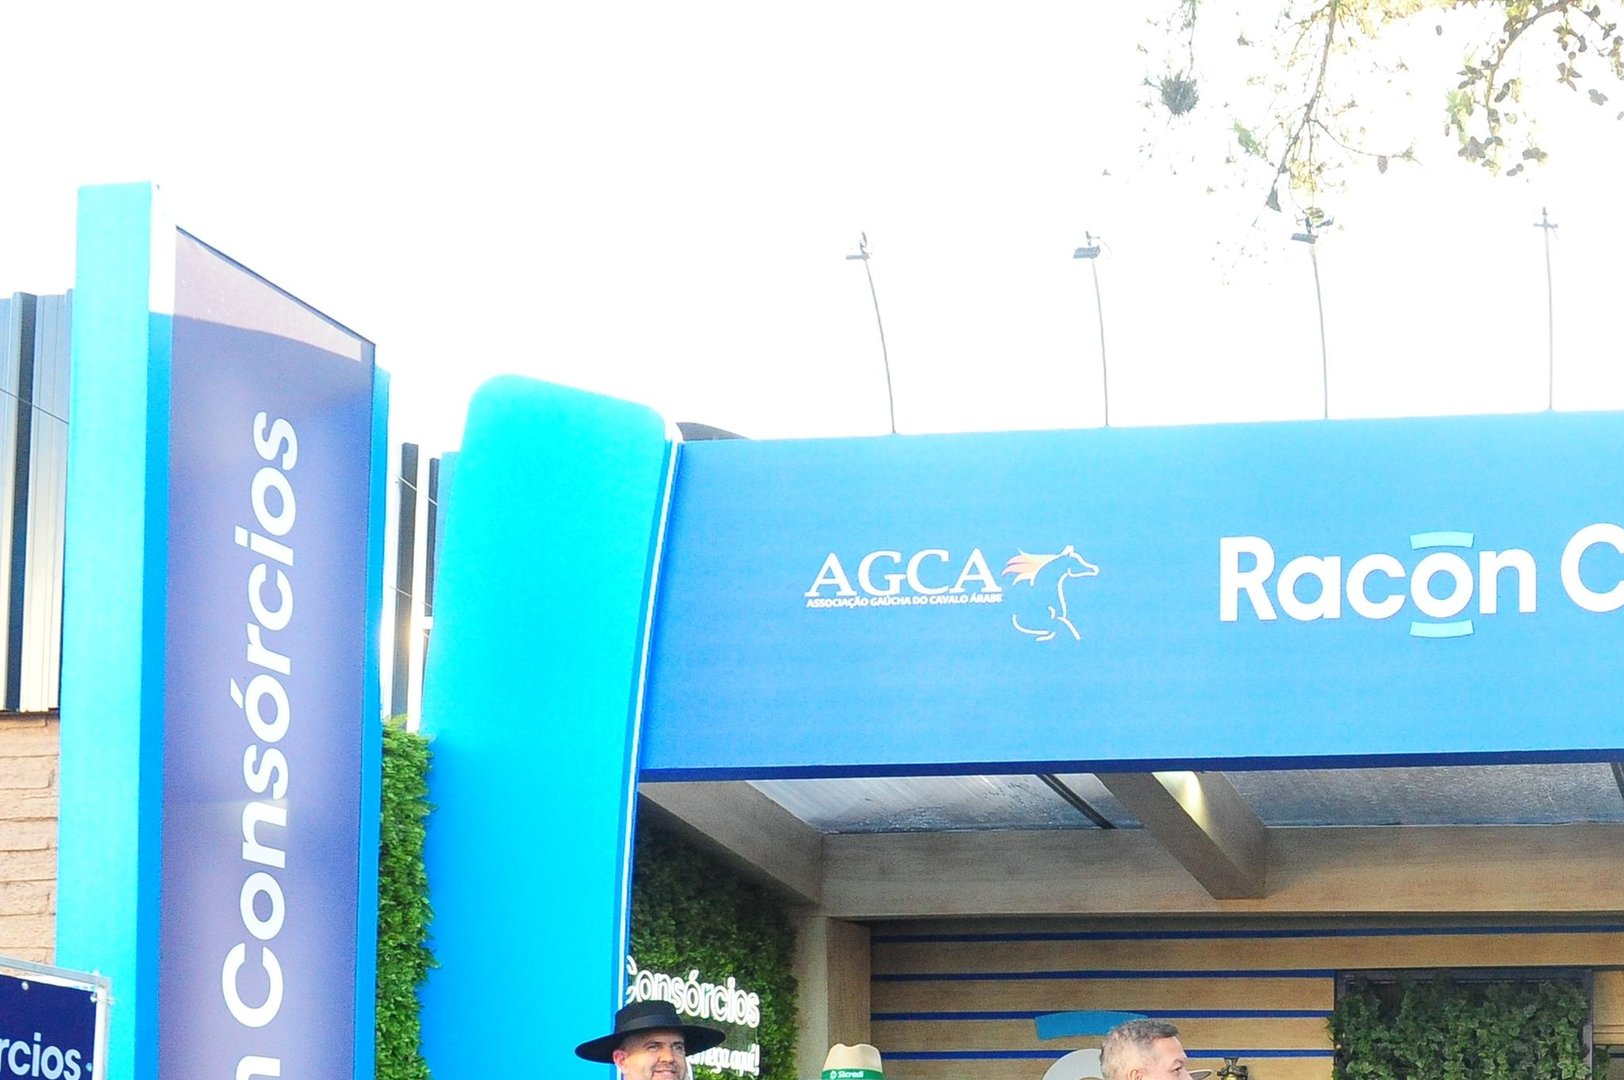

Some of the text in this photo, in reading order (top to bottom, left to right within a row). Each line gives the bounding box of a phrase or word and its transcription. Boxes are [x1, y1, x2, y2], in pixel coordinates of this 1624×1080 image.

[803, 547, 1002, 598] AGCA
[1219, 531, 1538, 638] Racon
[222, 411, 299, 1029] Consórcios
